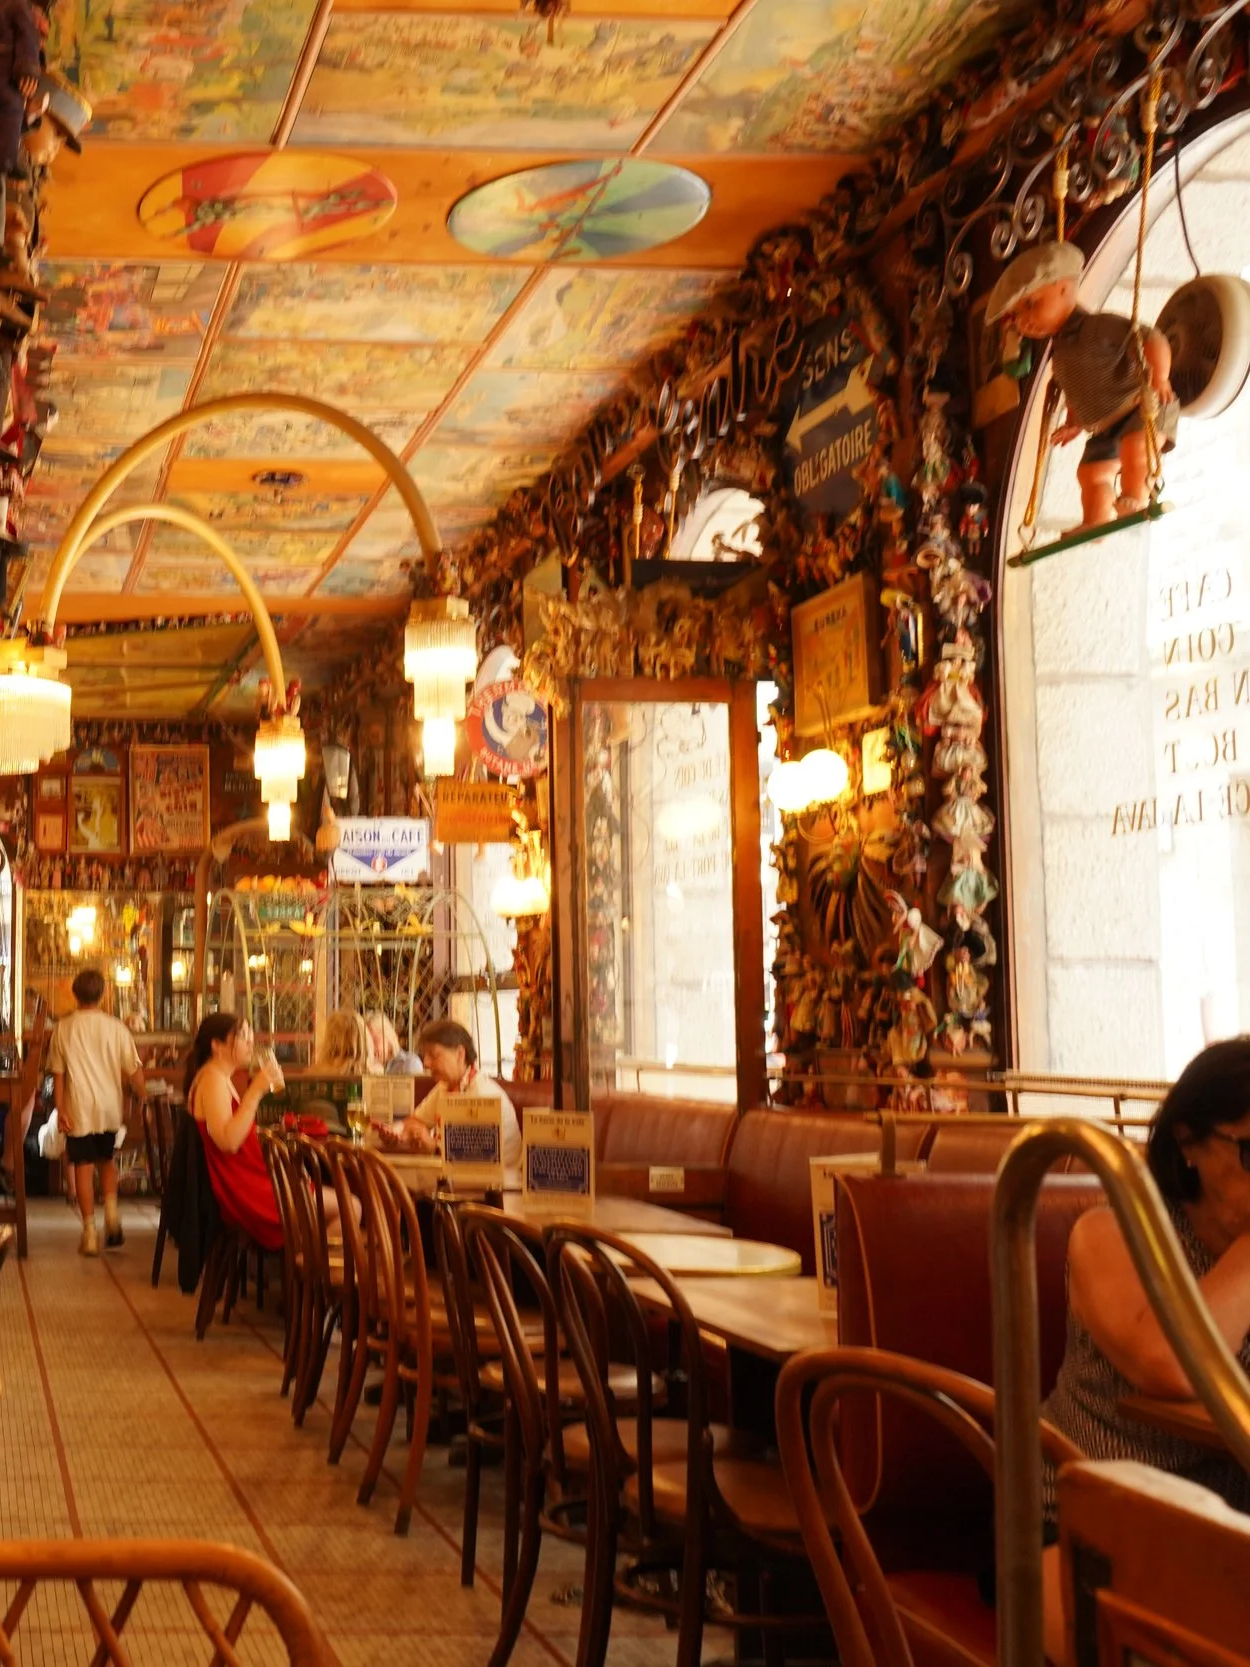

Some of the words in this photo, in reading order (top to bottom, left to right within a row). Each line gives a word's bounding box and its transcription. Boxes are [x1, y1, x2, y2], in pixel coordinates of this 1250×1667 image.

[802, 327, 855, 389] SENS
[793, 419, 873, 498] OBLIGATOIRE
[342, 829, 380, 843] AISON
